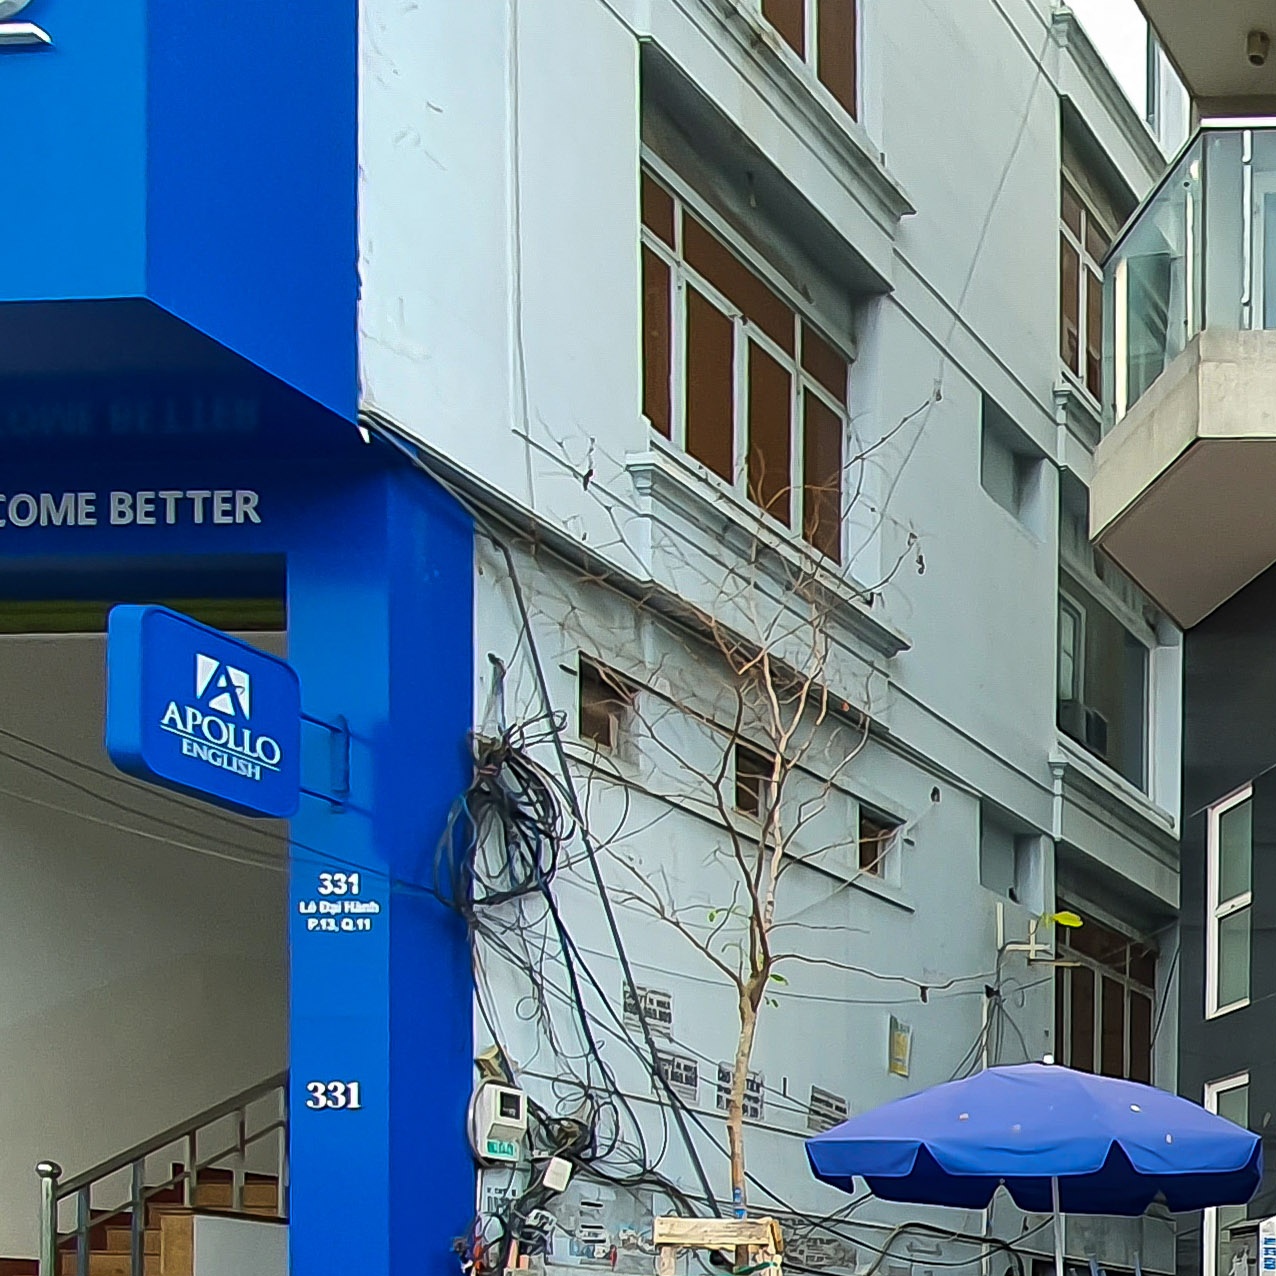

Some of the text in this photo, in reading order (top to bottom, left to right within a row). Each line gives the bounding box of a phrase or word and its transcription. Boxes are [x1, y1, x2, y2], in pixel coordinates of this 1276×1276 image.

[0, 490, 261, 528] OME BETTER
[160, 701, 281, 765] APOLLO
[182, 738, 261, 781] ENGLISH
[318, 873, 359, 895] 331
[306, 1081, 361, 1110] 331
